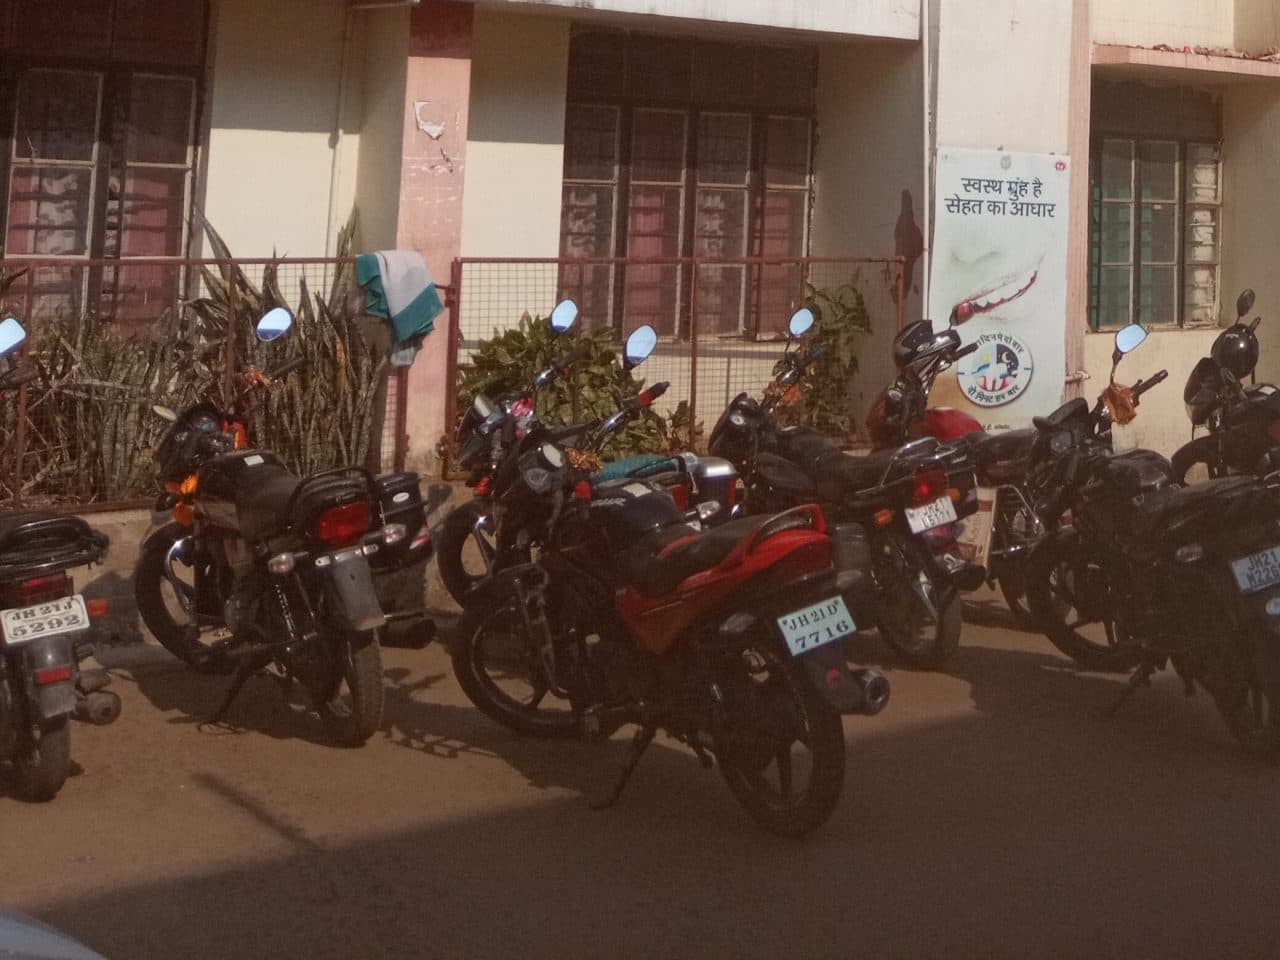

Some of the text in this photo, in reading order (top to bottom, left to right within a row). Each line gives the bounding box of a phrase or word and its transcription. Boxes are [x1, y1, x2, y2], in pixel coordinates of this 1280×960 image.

[960, 177, 1004, 195] स्वस्थ
[1032, 176, 1043, 198] है
[943, 193, 985, 215] सेहत
[986, 199, 1008, 216] का
[1247, 550, 1278, 570] JH21
[13, 614, 81, 637] 5292
[795, 620, 849, 649] 7716
